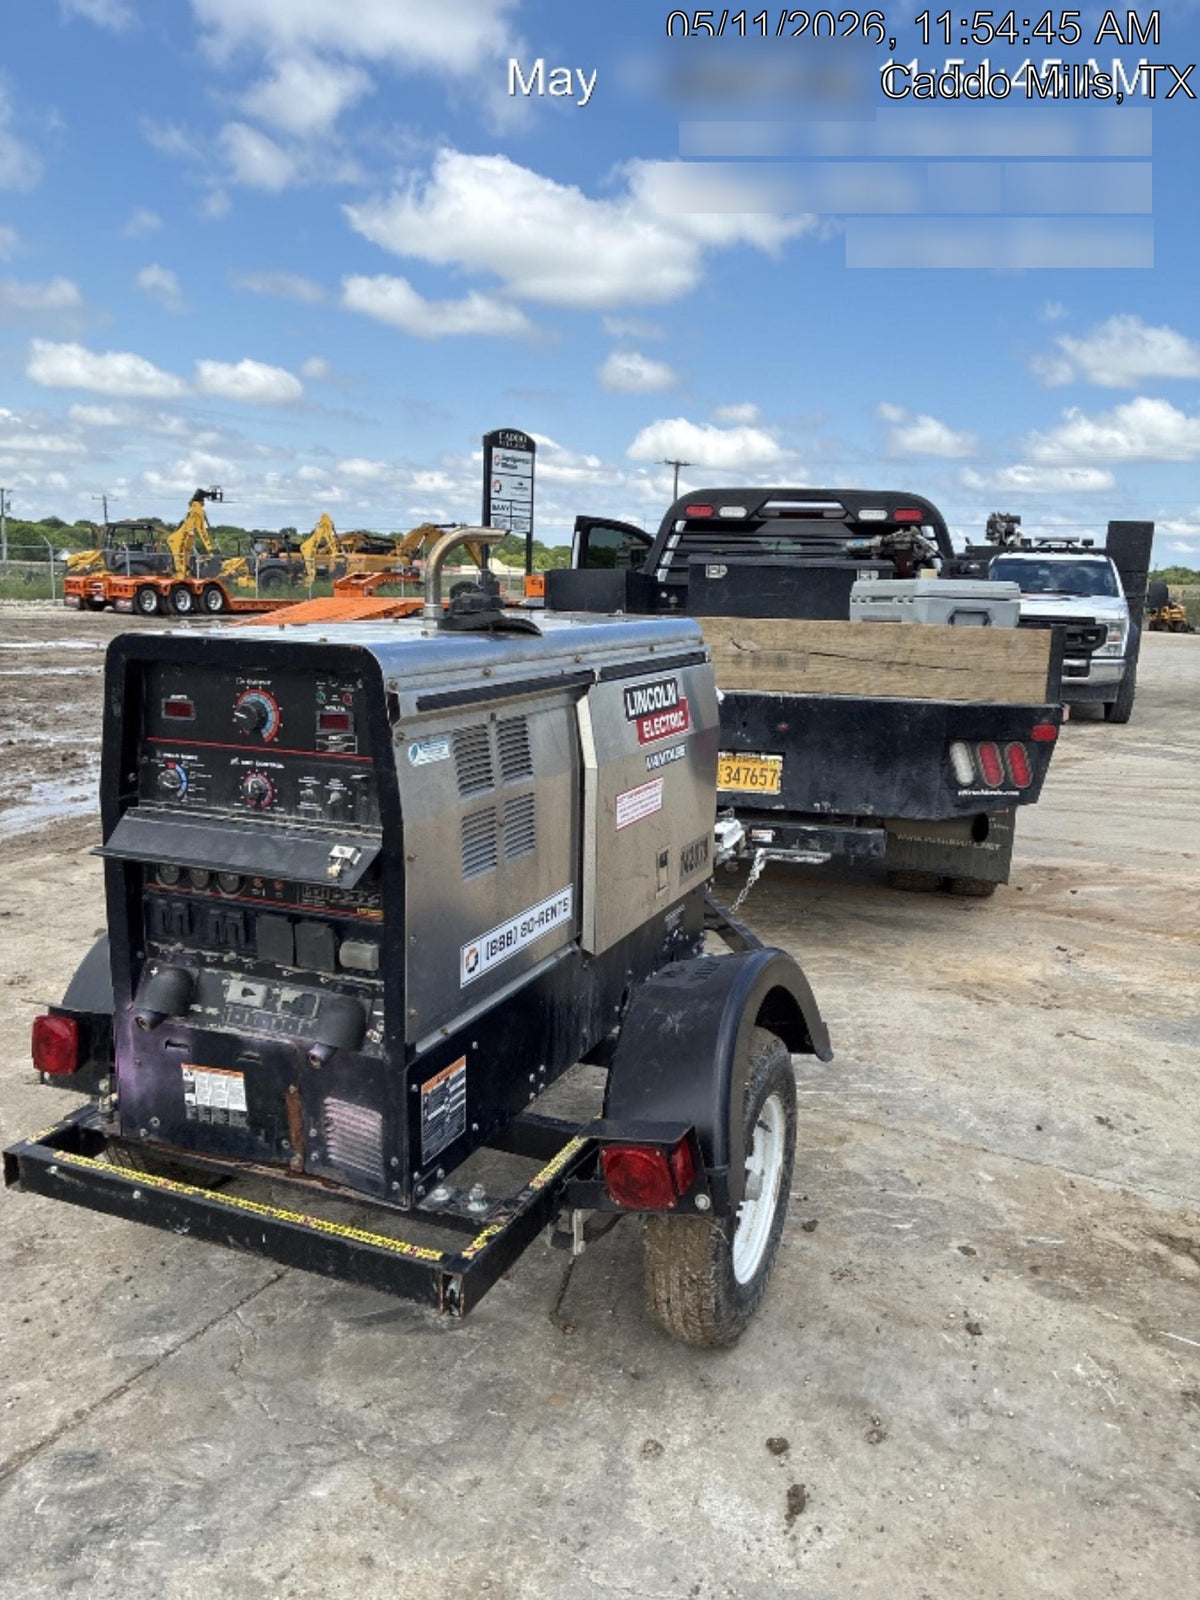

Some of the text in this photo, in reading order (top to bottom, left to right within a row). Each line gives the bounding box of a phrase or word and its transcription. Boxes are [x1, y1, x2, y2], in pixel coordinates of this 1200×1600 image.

[625, 681, 677, 717] LINCOLN
[643, 710, 685, 739] ELECTRIC
[723, 765, 778, 787] 347657
